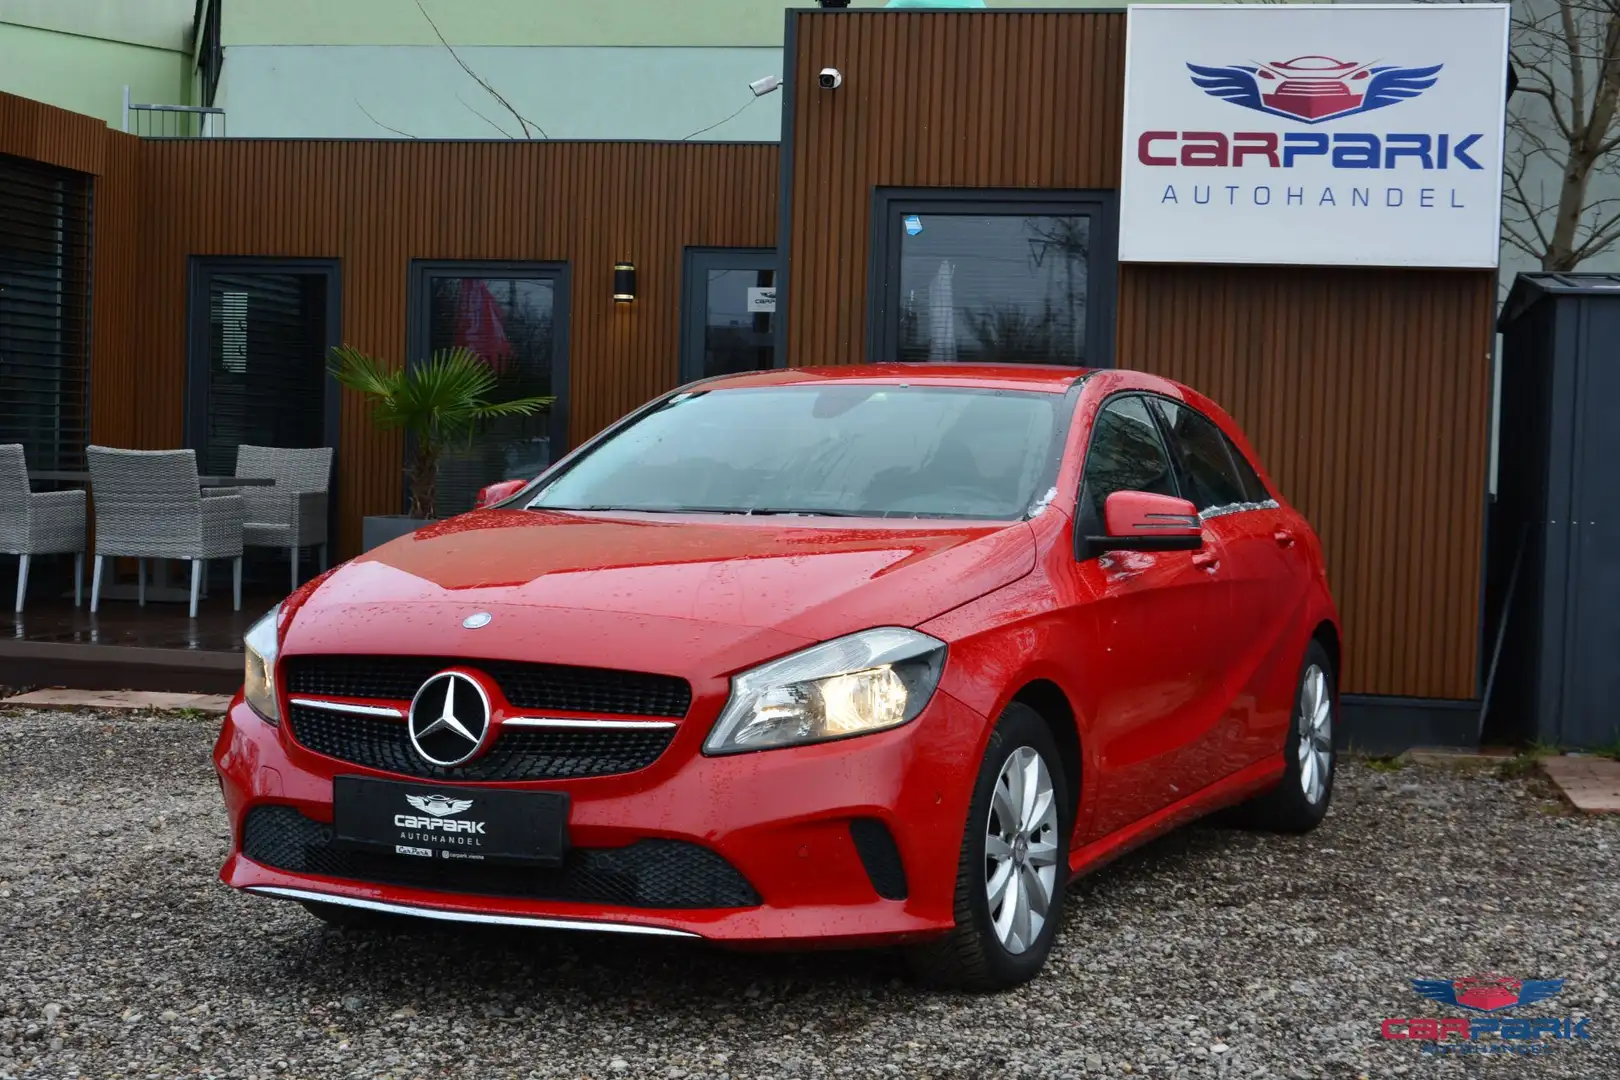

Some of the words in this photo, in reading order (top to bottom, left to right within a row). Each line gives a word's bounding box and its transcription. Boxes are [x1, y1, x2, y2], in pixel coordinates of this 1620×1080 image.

[1138, 131, 1484, 170] CARPARK
[1162, 185, 1464, 208] AUTOHANDEL
[394, 814, 486, 834] CARPARK
[400, 831, 482, 846] AUTOHANDEL
